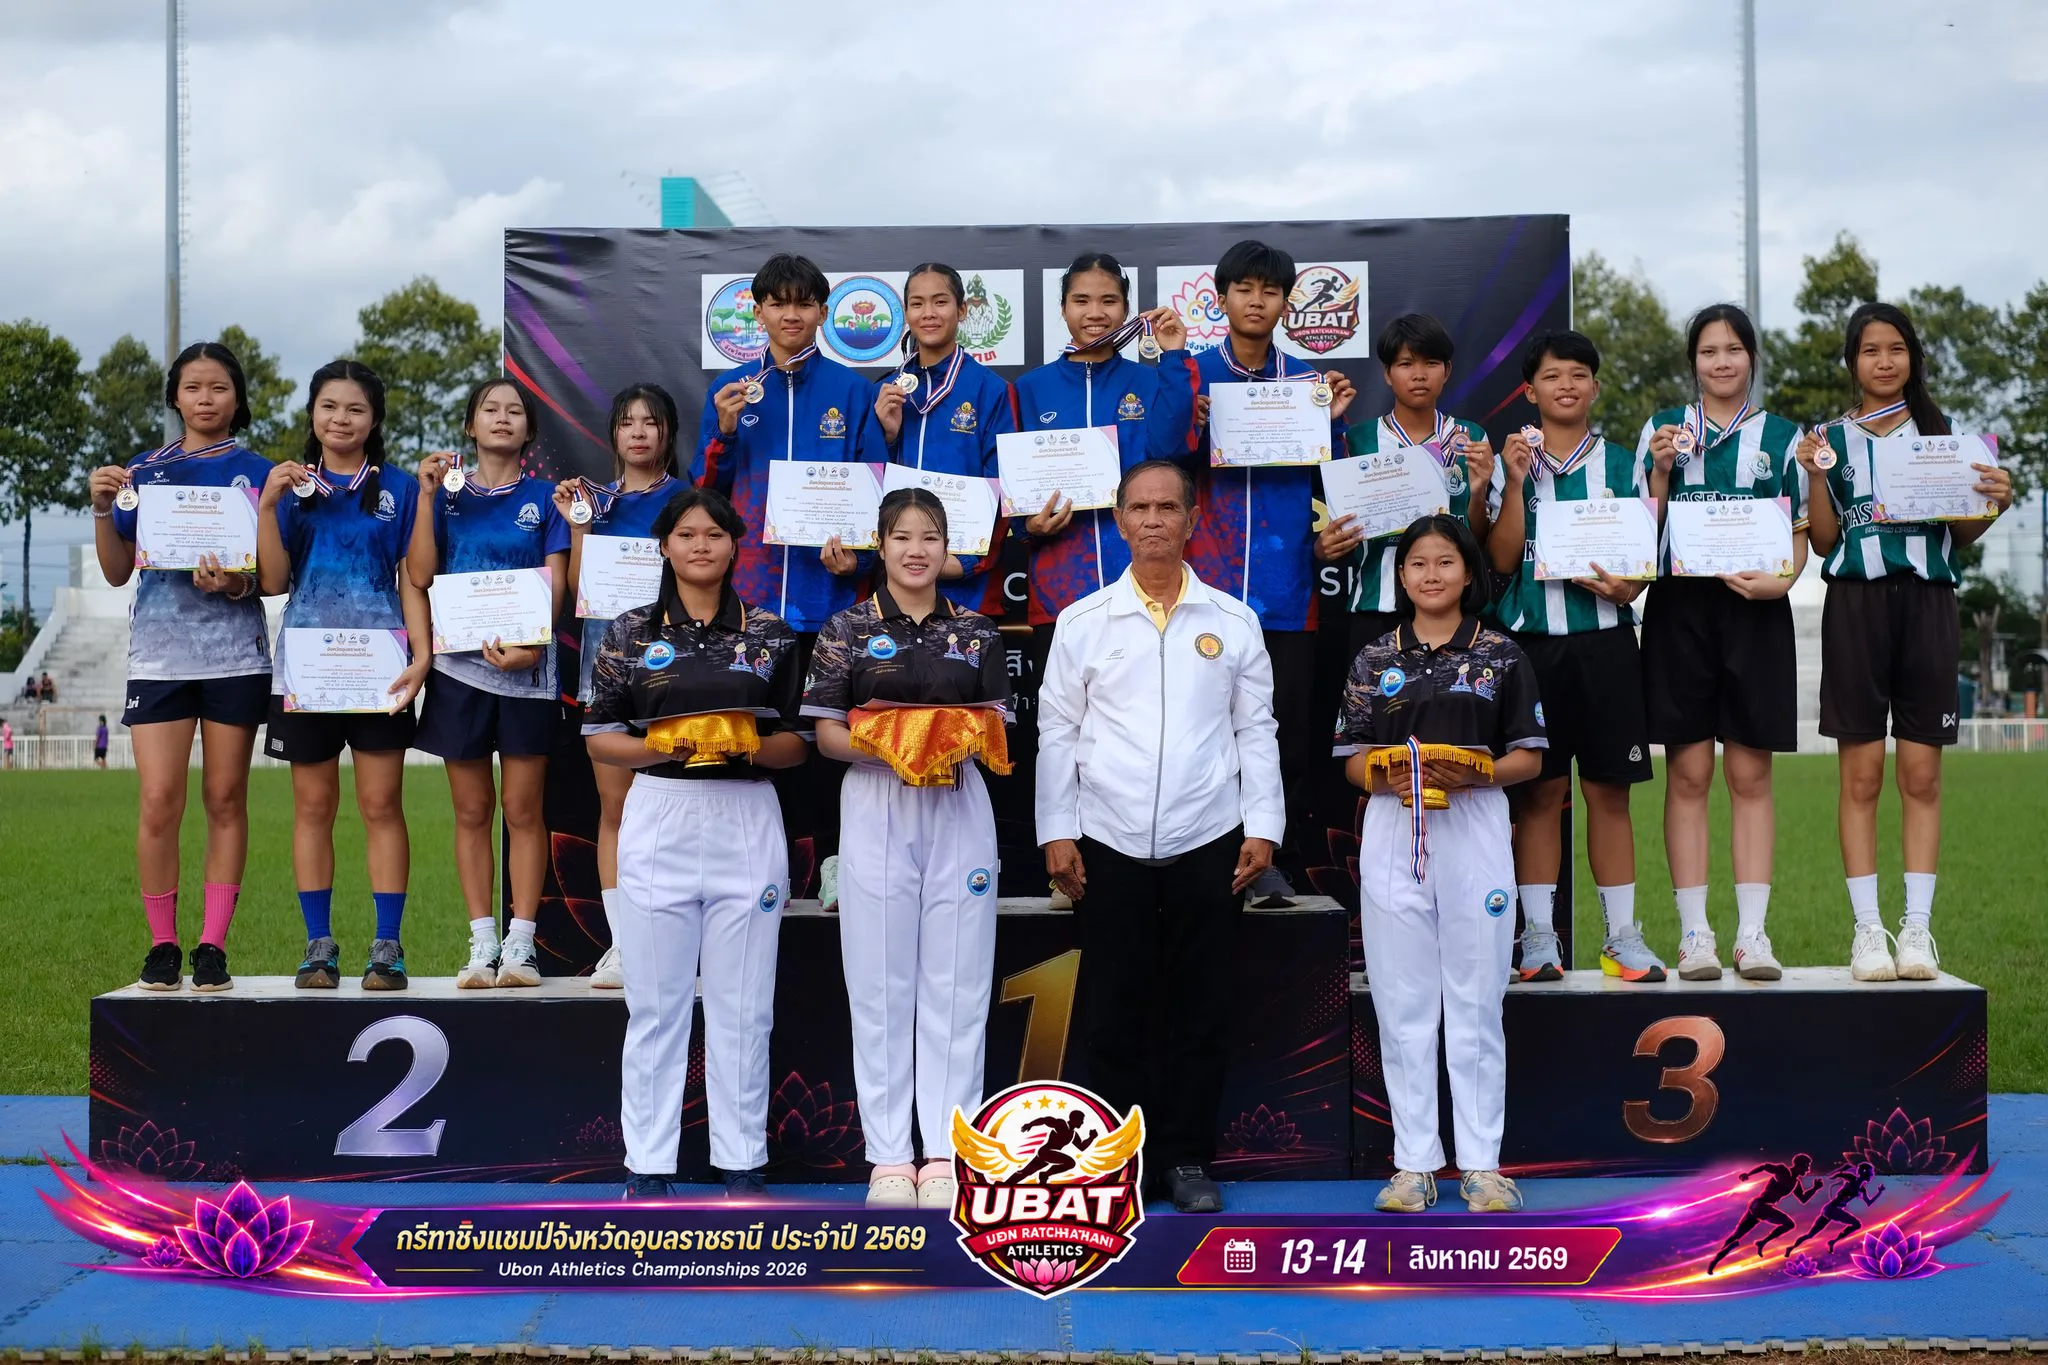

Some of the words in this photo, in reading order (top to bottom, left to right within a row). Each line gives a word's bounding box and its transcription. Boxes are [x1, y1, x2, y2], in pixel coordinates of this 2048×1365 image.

[1288, 310, 1353, 329] UBAT
[1000, 949, 1082, 1084] 1
[1622, 1015, 1726, 1143] 3
[333, 1015, 450, 1156] 2
